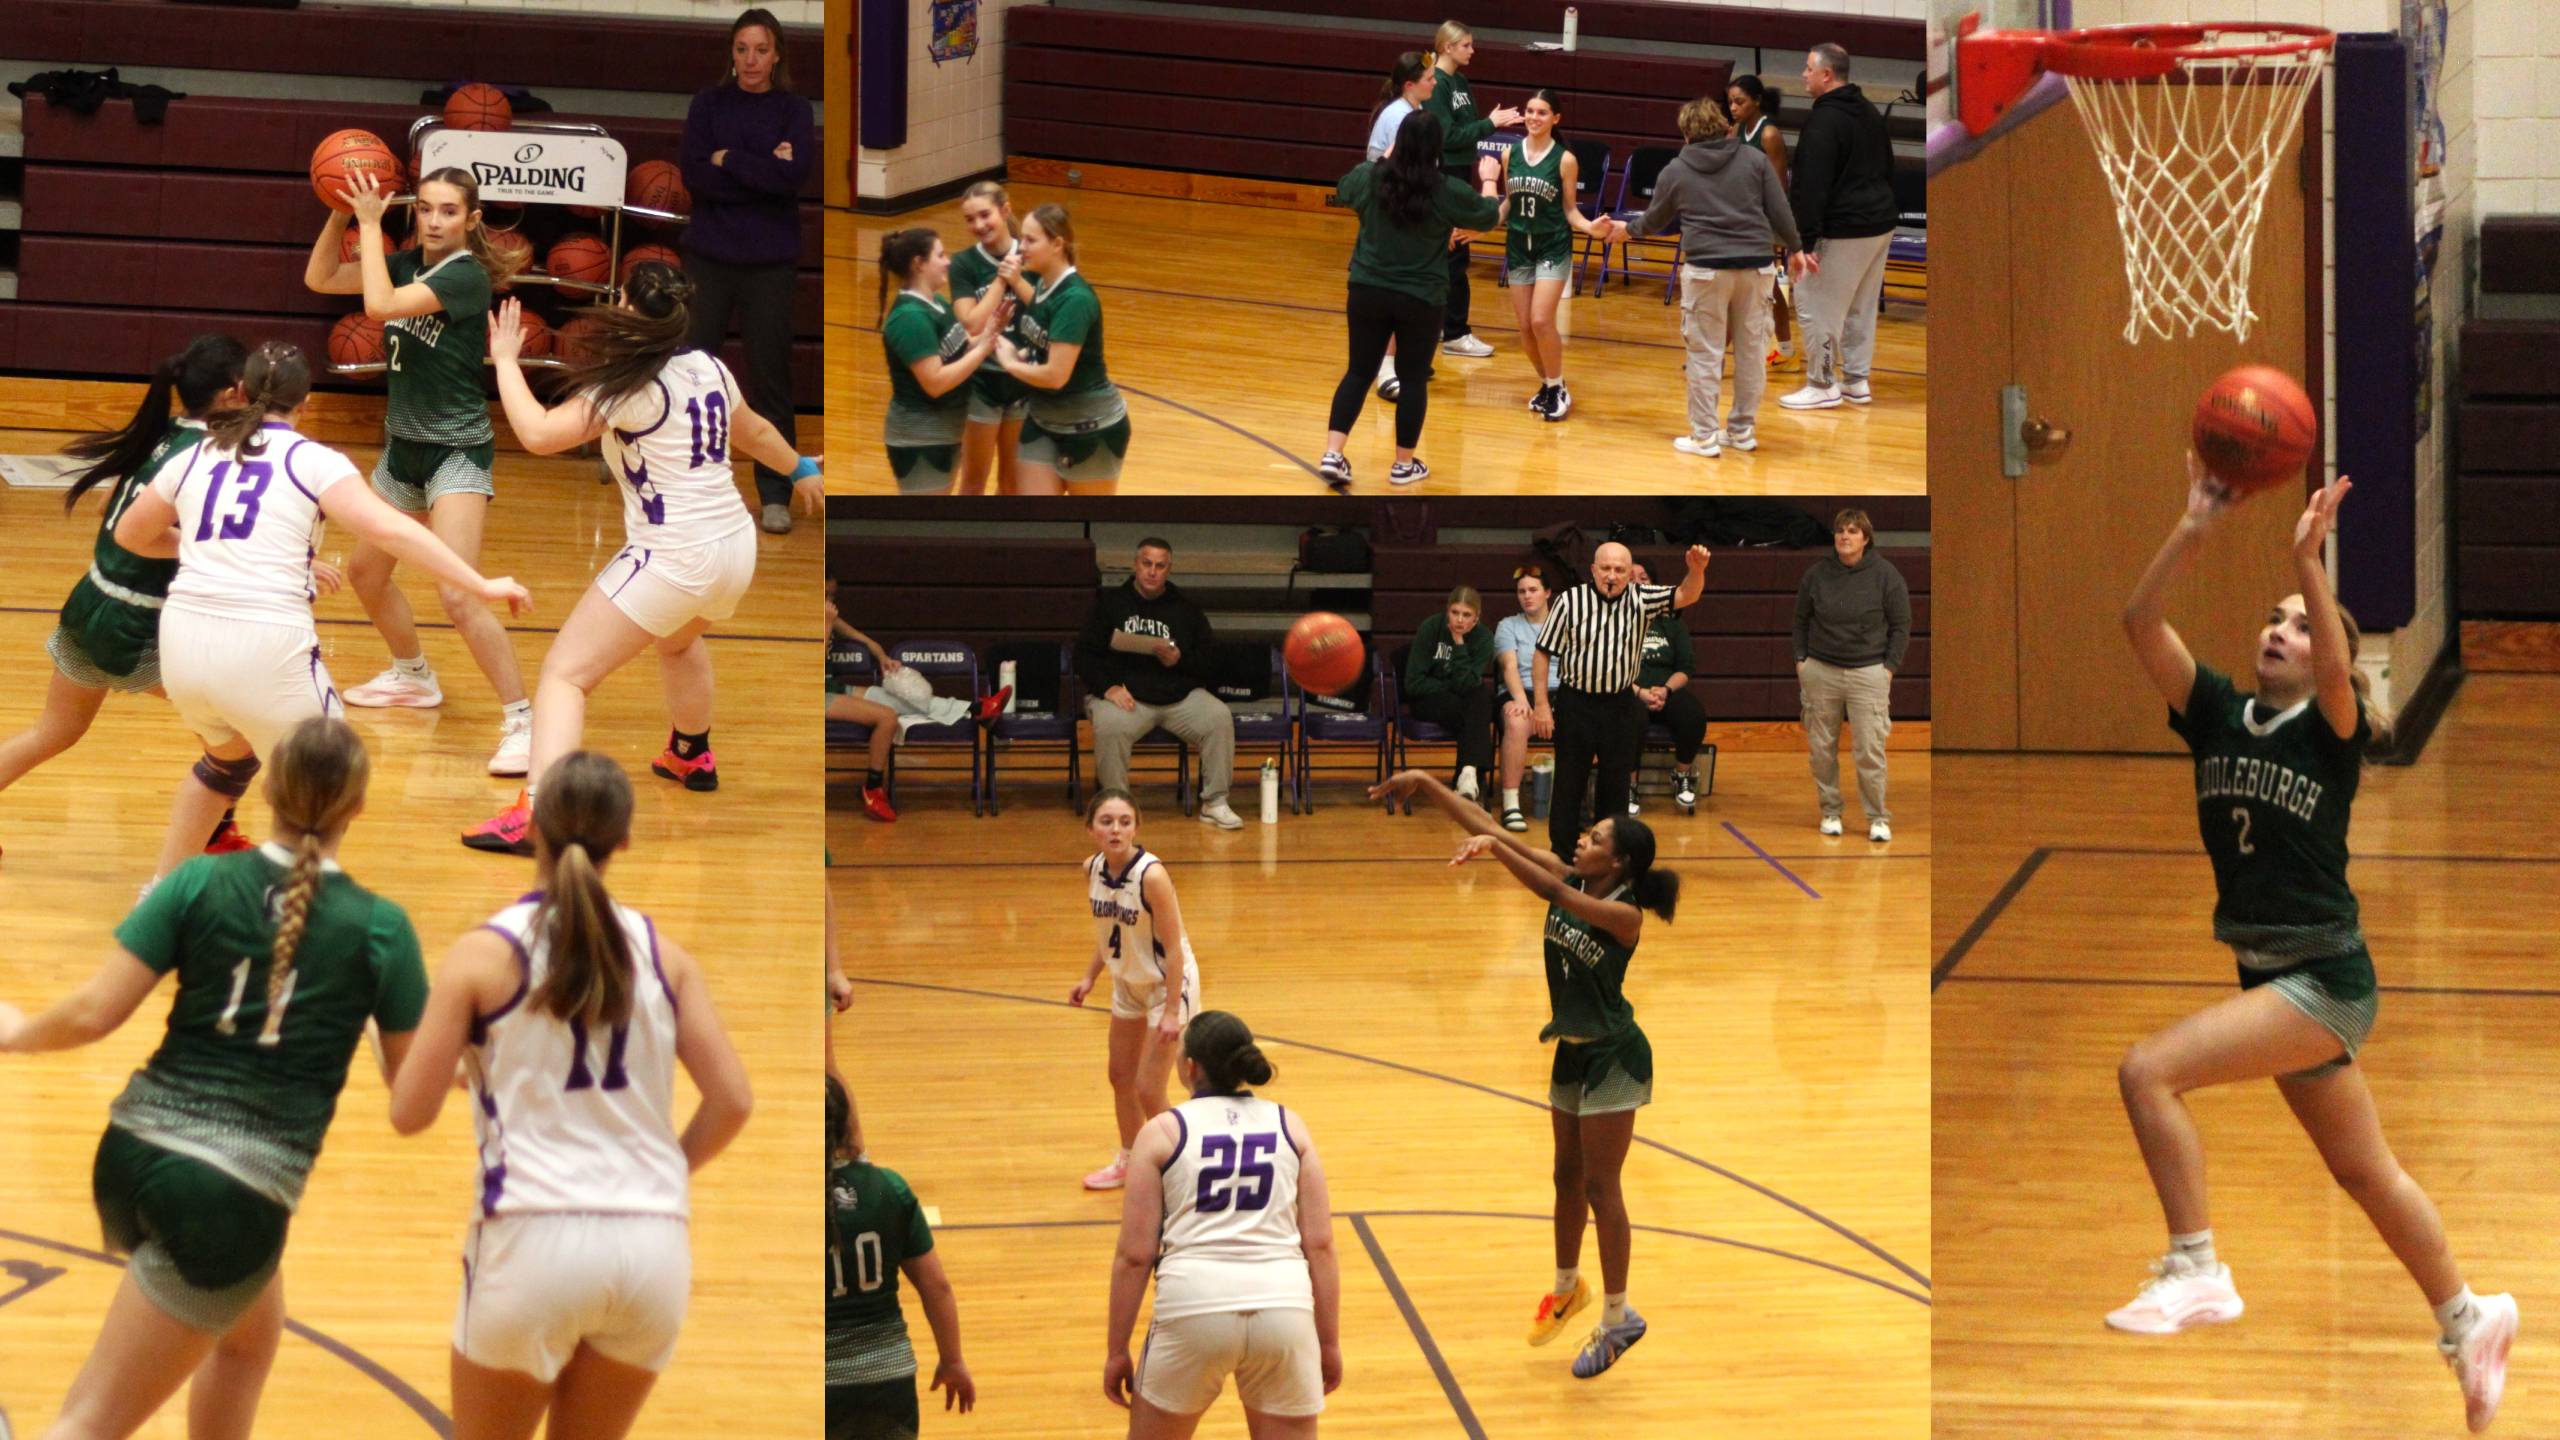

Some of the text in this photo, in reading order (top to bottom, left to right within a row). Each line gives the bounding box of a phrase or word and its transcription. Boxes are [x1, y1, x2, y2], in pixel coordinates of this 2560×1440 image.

[471, 161, 586, 193] SPALDING
[1520, 196, 1536, 218] 13
[390, 335, 401, 371] 2
[686, 390, 728, 469] 10
[195, 460, 274, 542] 13
[902, 651, 965, 663] SPARTANS
[2232, 806, 2255, 855] 2
[1109, 924, 1121, 959] 4
[215, 956, 299, 1045] 11
[1195, 1131, 1278, 1213] 25
[829, 1231, 884, 1297] 10
